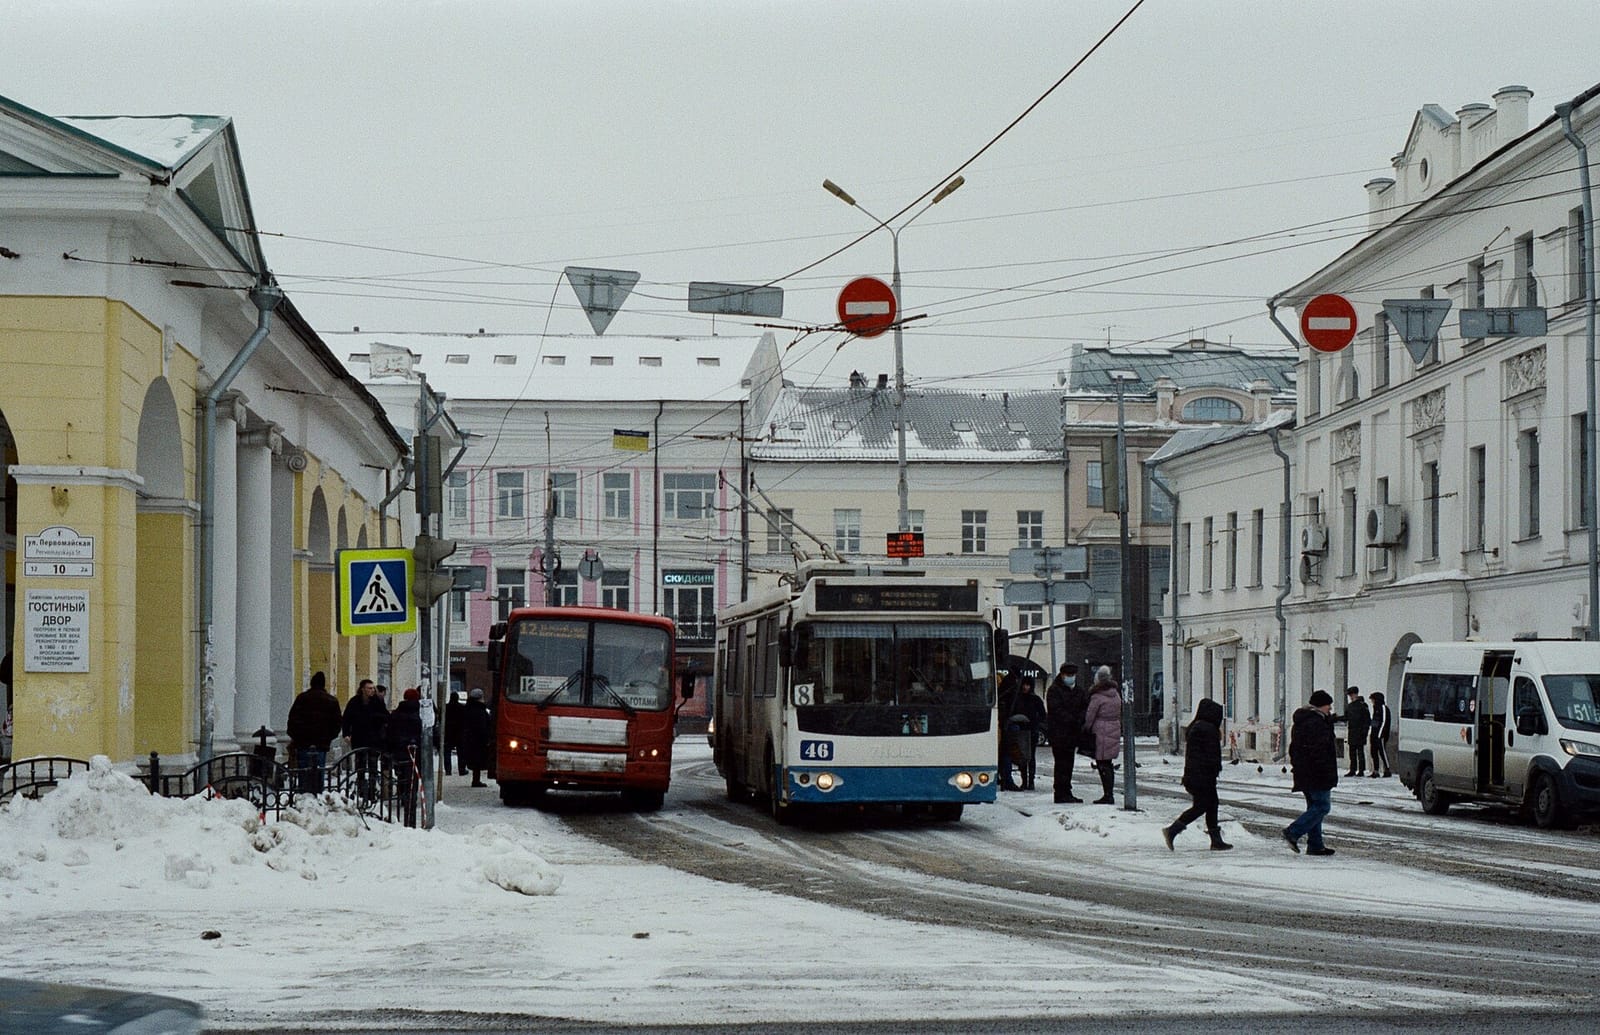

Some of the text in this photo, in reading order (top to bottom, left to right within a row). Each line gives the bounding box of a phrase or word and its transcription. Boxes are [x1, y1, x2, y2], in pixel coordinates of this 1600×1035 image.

[40, 539, 91, 547] Первомайская
[53, 564, 66, 574] 10
[28, 601, 86, 612] ГОСТИНЫЙ
[42, 615, 72, 626] ДВОР
[522, 678, 536, 692] 12
[798, 685, 810, 705] 8
[1573, 703, 1591, 721] 51
[804, 742, 830, 759] 46
